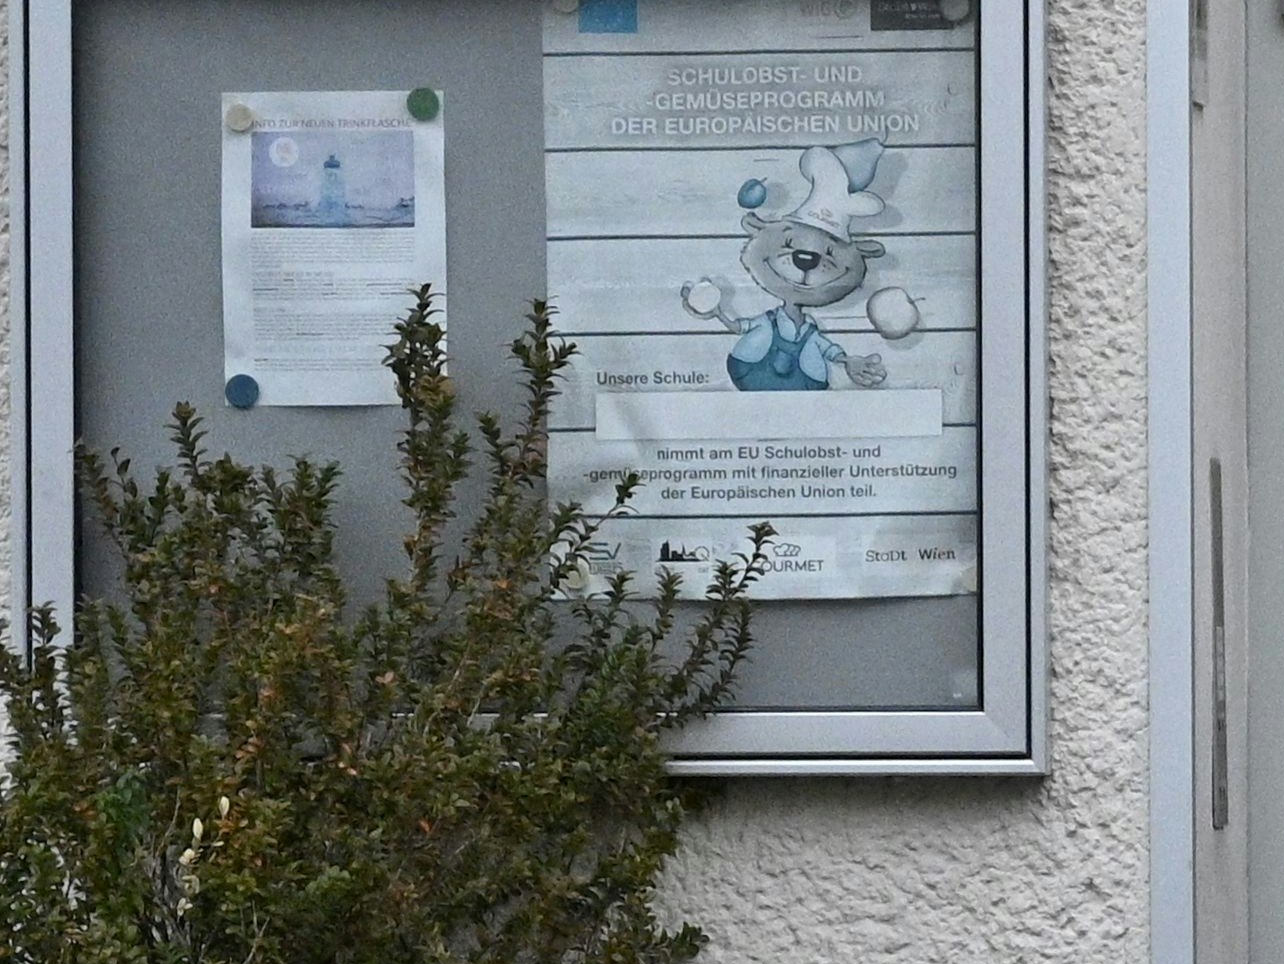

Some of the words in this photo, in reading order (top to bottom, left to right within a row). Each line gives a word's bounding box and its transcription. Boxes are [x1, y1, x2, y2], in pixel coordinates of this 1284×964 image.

[667, 66, 807, 87] SCHULOBST-
[814, 65, 863, 83] UND
[646, 88, 886, 112] -GEMÜSEPROGRAMM
[611, 117, 660, 136] DER
[665, 113, 840, 134] EUROPÄISCHEN
[846, 113, 920, 133] UNION
[596, 371, 649, 385] Unsere
[653, 370, 710, 385] Schule:
[657, 447, 704, 460] nimmt
[709, 449, 733, 460] am
[738, 446, 760, 460] EU
[765, 445, 848, 460] Schulobst-
[852, 445, 882, 459] und
[732, 466, 757, 480] mit
[761, 465, 845, 480] finanzieller
[849, 463, 958, 482] Unterstützung
[661, 486, 686, 500] der
[691, 485, 796, 502] Europäischen
[801, 485, 845, 499] Union
[850, 484, 877, 499] teil.
[918, 546, 956, 561] Wien
[757, 559, 824, 573] OURMET
